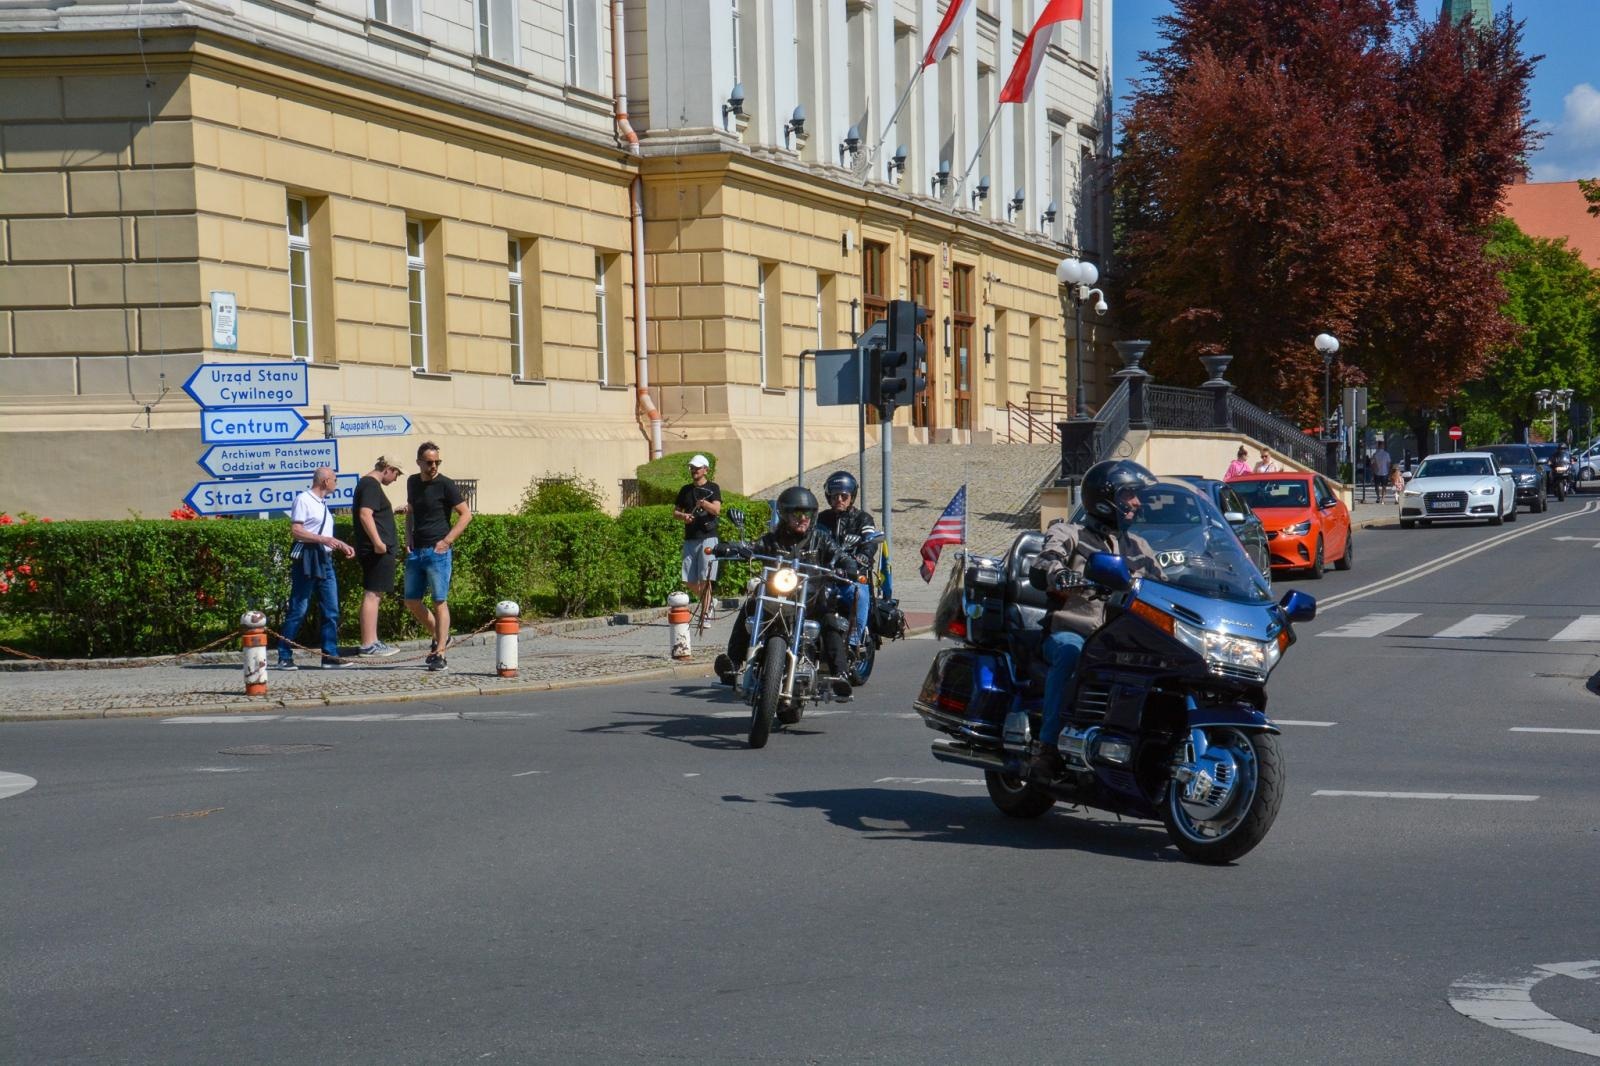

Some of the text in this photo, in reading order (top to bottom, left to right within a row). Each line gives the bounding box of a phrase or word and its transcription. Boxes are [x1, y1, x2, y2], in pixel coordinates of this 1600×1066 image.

[211, 369, 298, 385] Urząd Stanu
[220, 387, 293, 403] Cywilnego
[211, 418, 289, 434] Centrum
[340, 420, 370, 432] Aquapark
[221, 449, 271, 459] Archiwum
[222, 461, 264, 472] Oddział
[280, 459, 331, 470] Raciborzu
[204, 488, 252, 506] Straż
